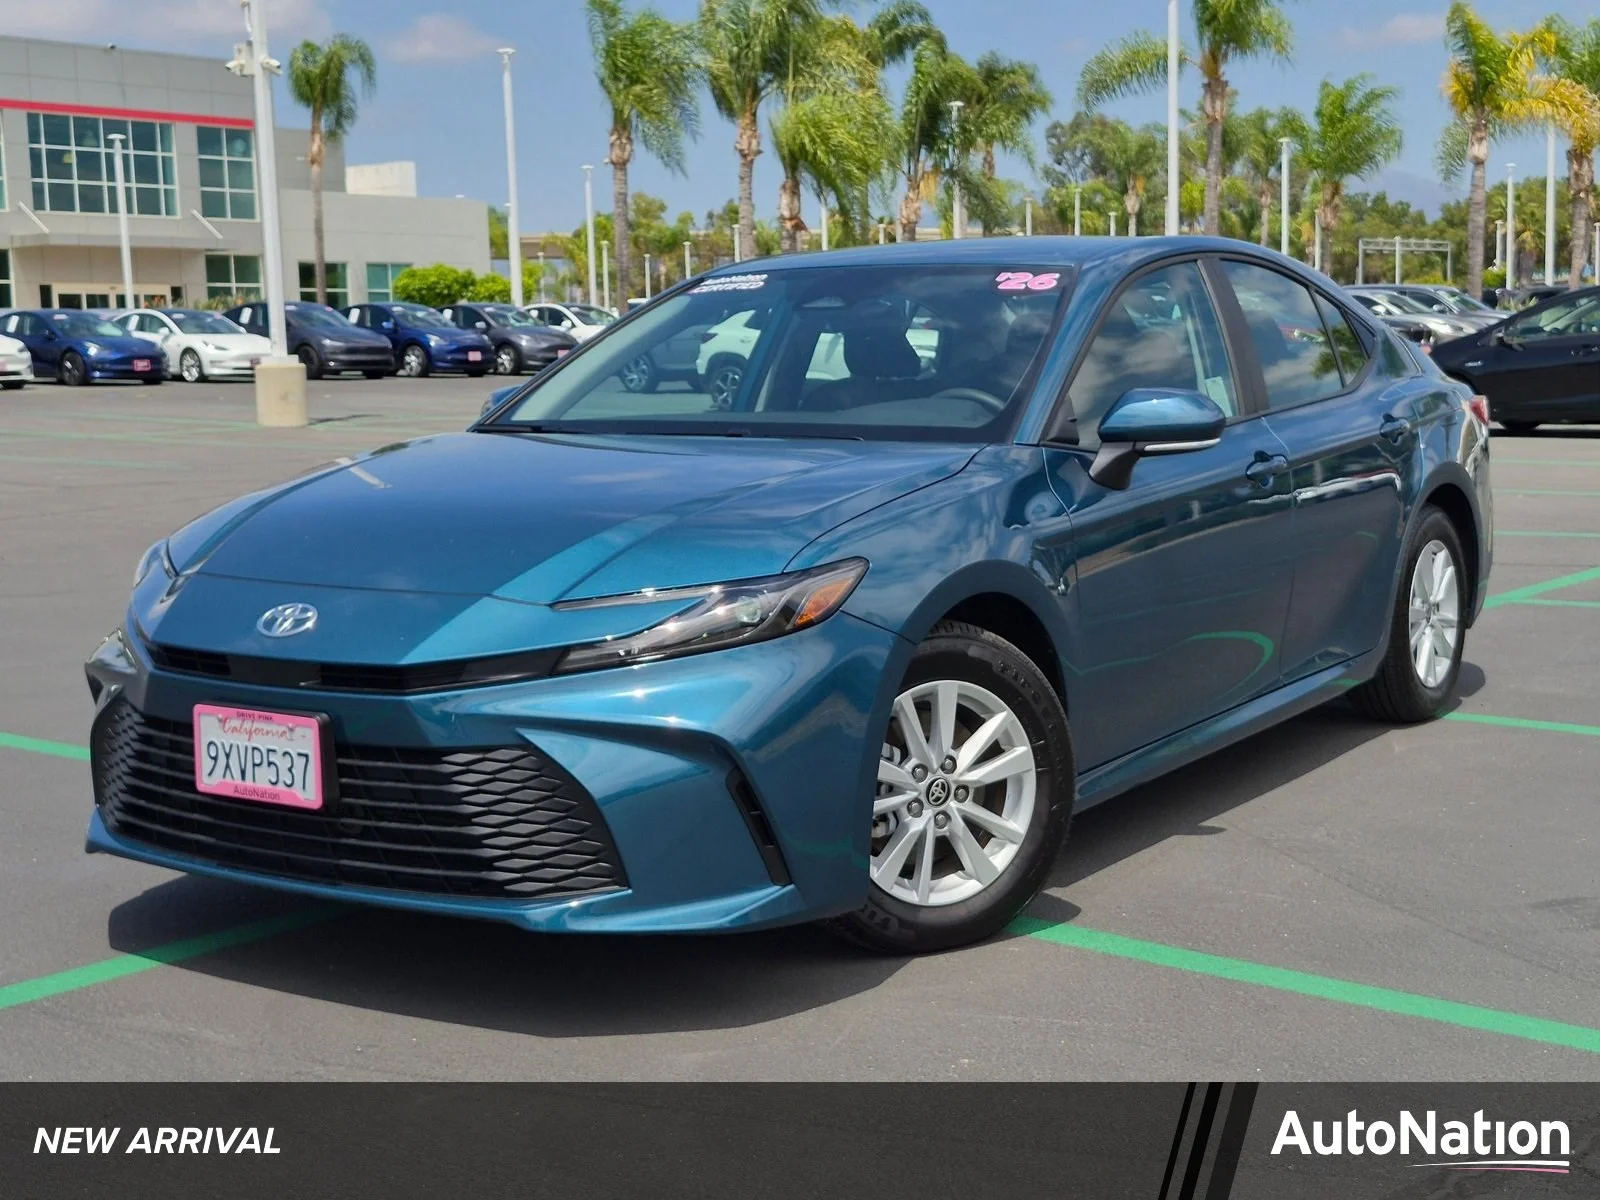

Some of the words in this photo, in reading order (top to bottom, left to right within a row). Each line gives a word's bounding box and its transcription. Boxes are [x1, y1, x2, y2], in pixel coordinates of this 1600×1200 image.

[236, 711, 256, 720] DRIVE
[257, 714, 274, 722] PINK
[221, 717, 291, 742] California
[207, 739, 311, 792] 9XVP537
[233, 784, 281, 801] AutoNation
